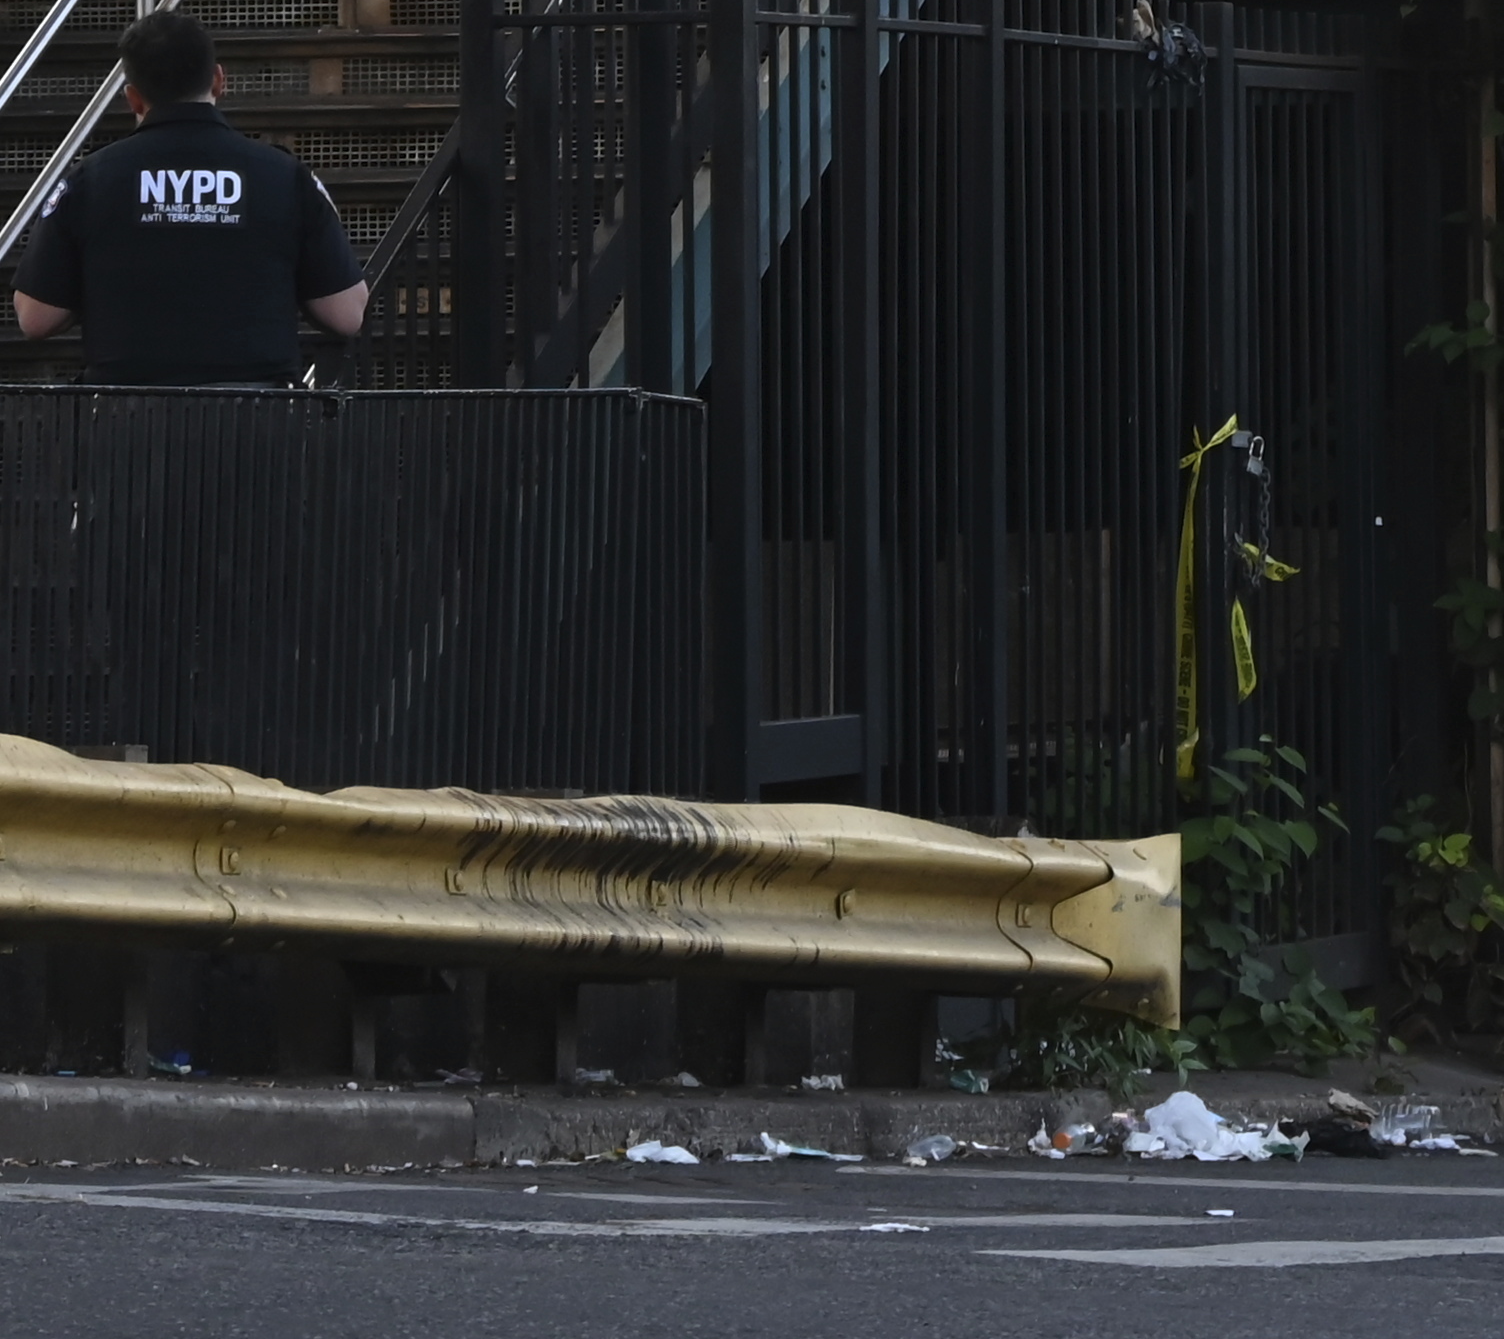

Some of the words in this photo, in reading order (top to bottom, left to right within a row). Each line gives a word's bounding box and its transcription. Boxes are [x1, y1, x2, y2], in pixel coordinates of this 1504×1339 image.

[140, 170, 242, 204] NYPD
[153, 204, 191, 213] TRANSIT
[195, 204, 230, 214] BUREAU
[141, 213, 162, 222] ANTI
[167, 213, 216, 223] TERRORISM
[220, 214, 241, 224] UNIT
